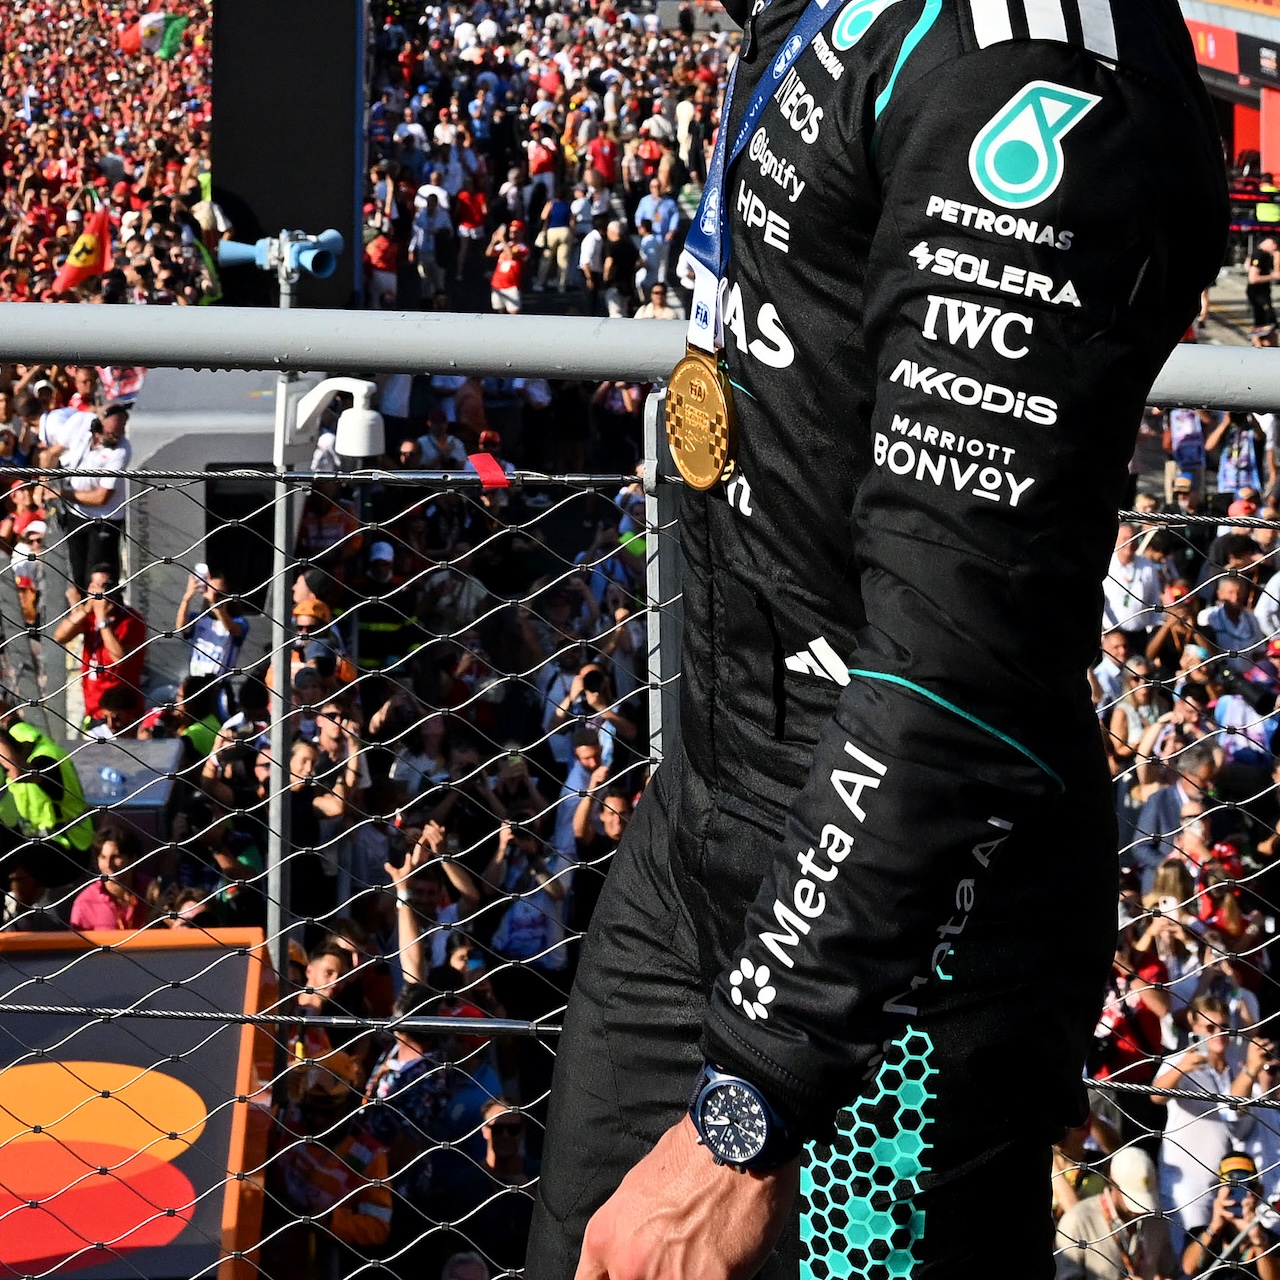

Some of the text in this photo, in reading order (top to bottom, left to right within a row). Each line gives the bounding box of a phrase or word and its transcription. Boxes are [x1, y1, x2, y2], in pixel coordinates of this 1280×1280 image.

[773, 66, 825, 145] INEOS
[925, 195, 1075, 251] PETRONAS
[929, 248, 1083, 308] SOLERA
[694, 306, 711, 329] FIA
[921, 294, 1034, 360] IWC
[874, 431, 1036, 508] BONVOY
[891, 414, 1017, 465] MARRIOTT
[758, 740, 889, 969] Meta AI
